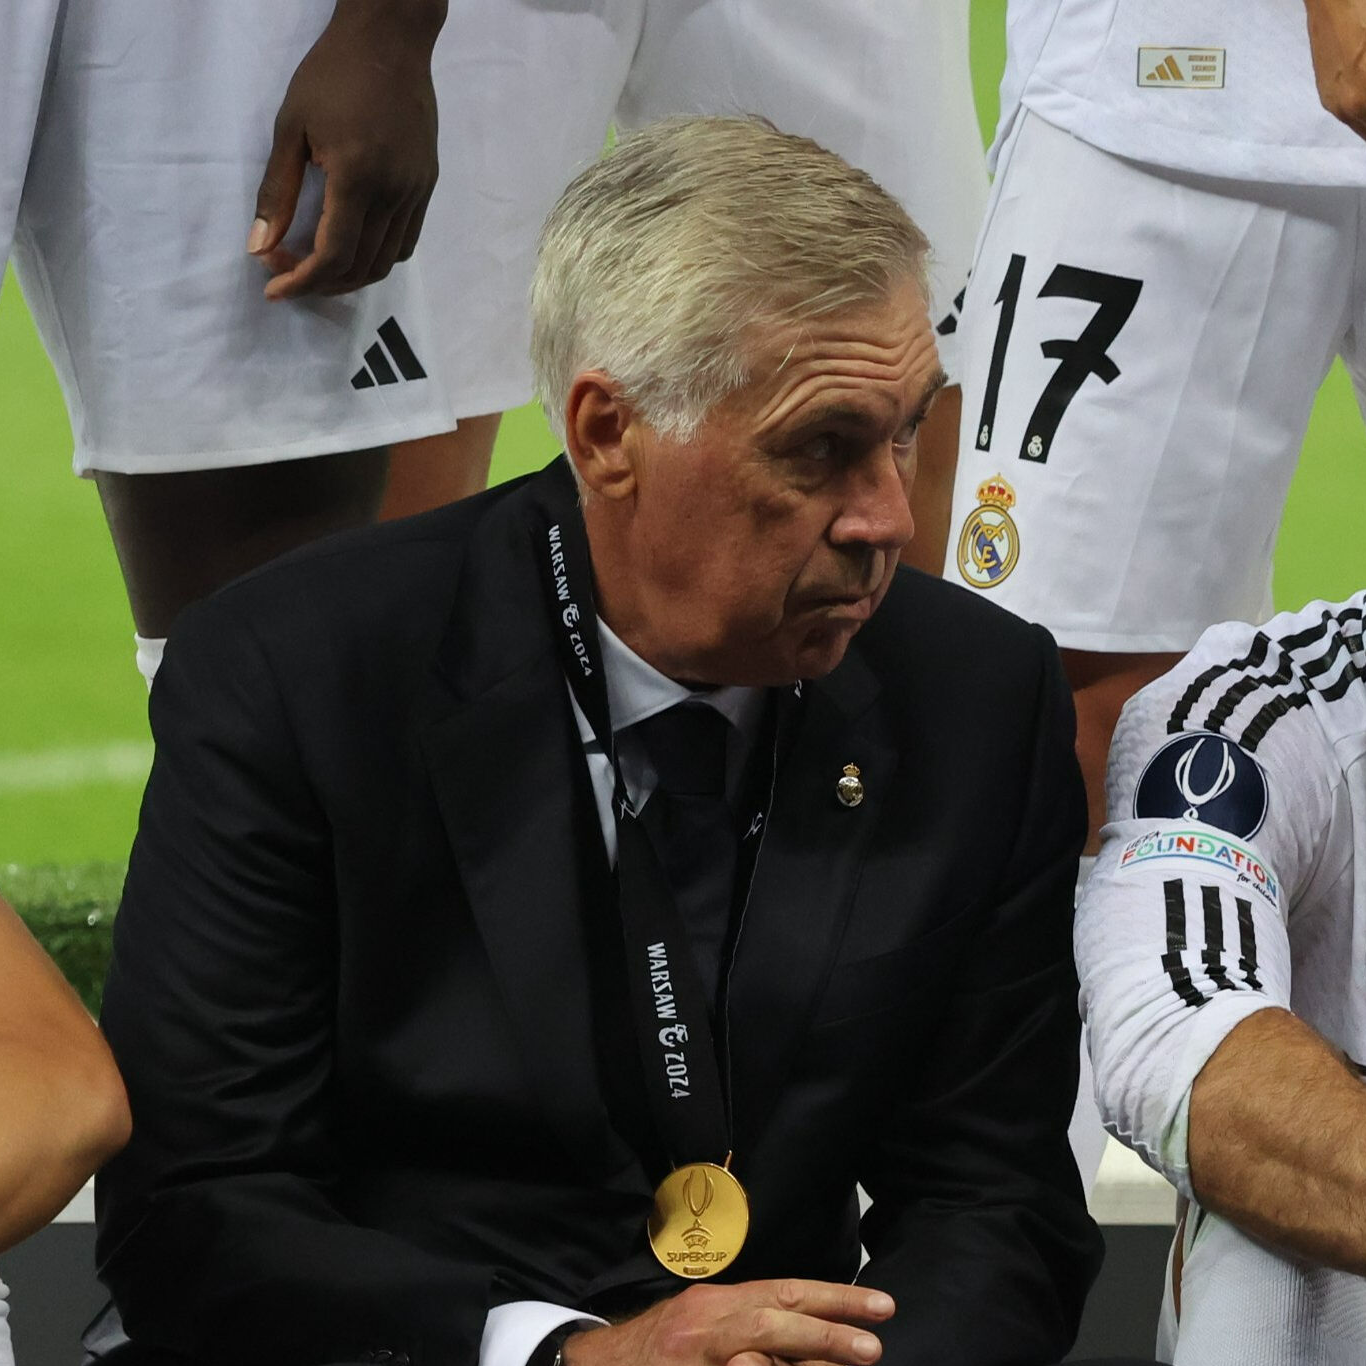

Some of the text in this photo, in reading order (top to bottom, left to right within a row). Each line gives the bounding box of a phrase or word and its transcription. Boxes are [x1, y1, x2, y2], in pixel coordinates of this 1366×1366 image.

[975, 253, 1144, 465] 17
[548, 524, 593, 677] WARSAW 2024
[647, 942, 692, 1099] WARSAW 2024
[666, 1251, 727, 1263] SUPERCUP
